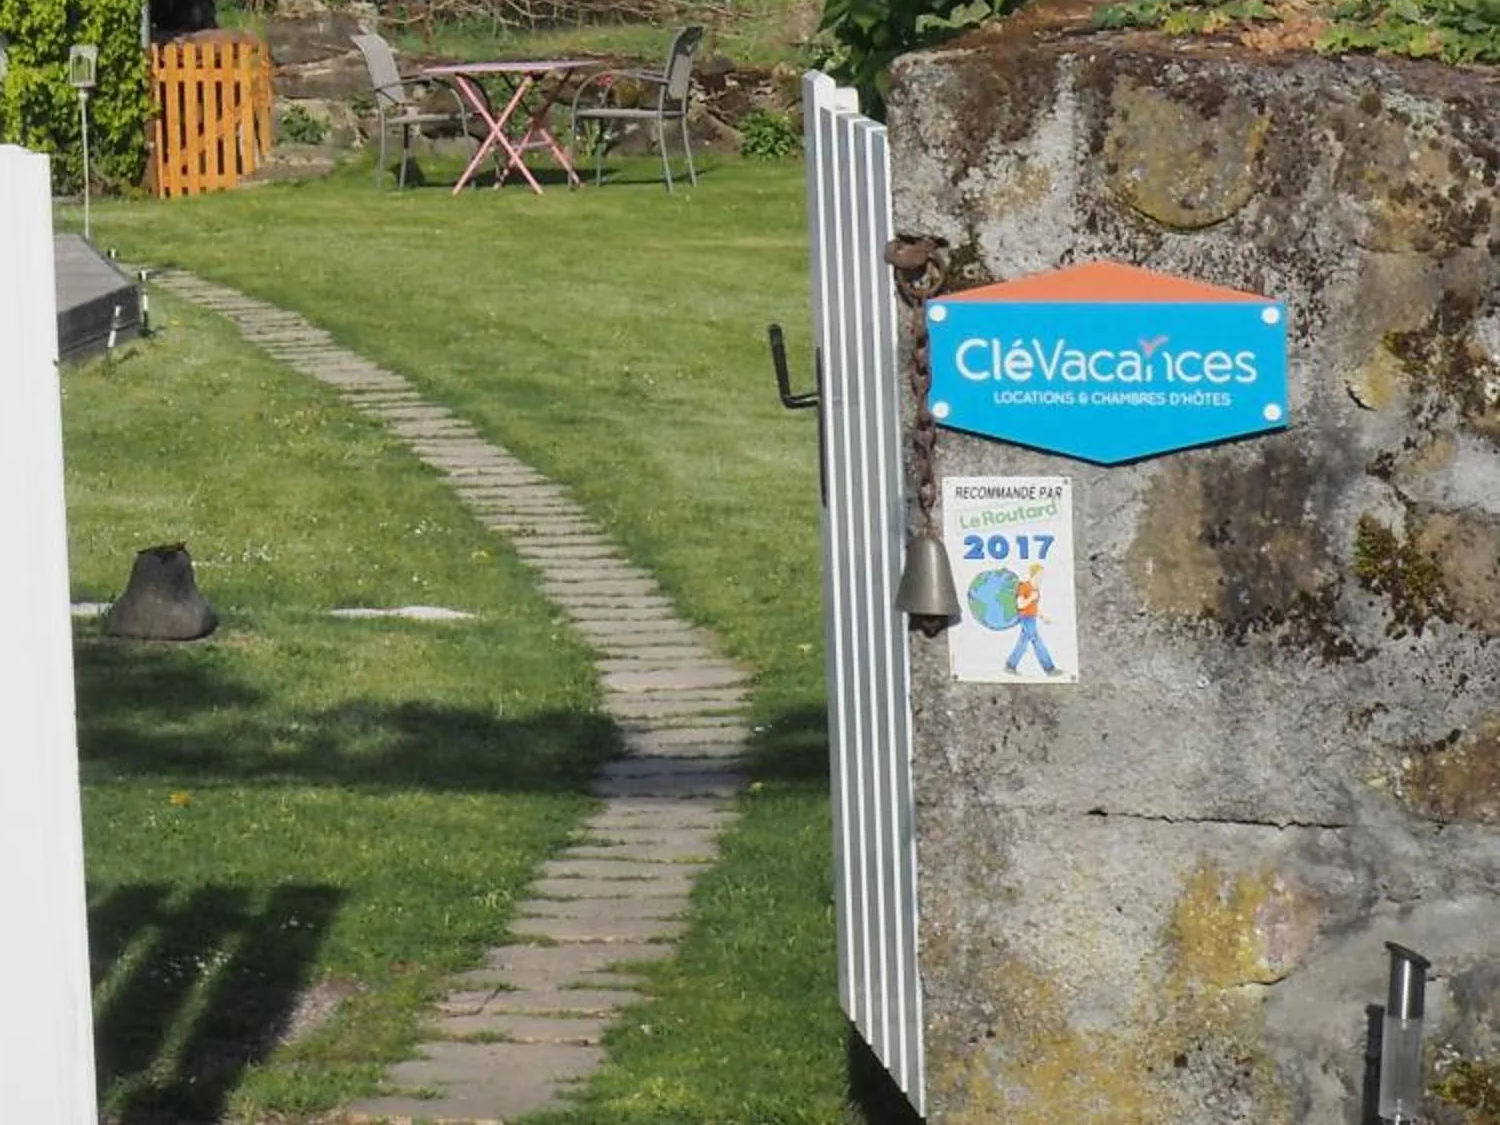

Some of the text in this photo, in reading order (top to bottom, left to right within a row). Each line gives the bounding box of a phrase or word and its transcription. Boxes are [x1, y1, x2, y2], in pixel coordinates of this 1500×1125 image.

[955, 335, 1258, 383] CléVacances
[993, 391, 1075, 405] LOCATIONS
[1091, 391, 1167, 406] CHAMBRES
[1040, 486, 1063, 500] PAR
[963, 534, 1055, 560] 2017
